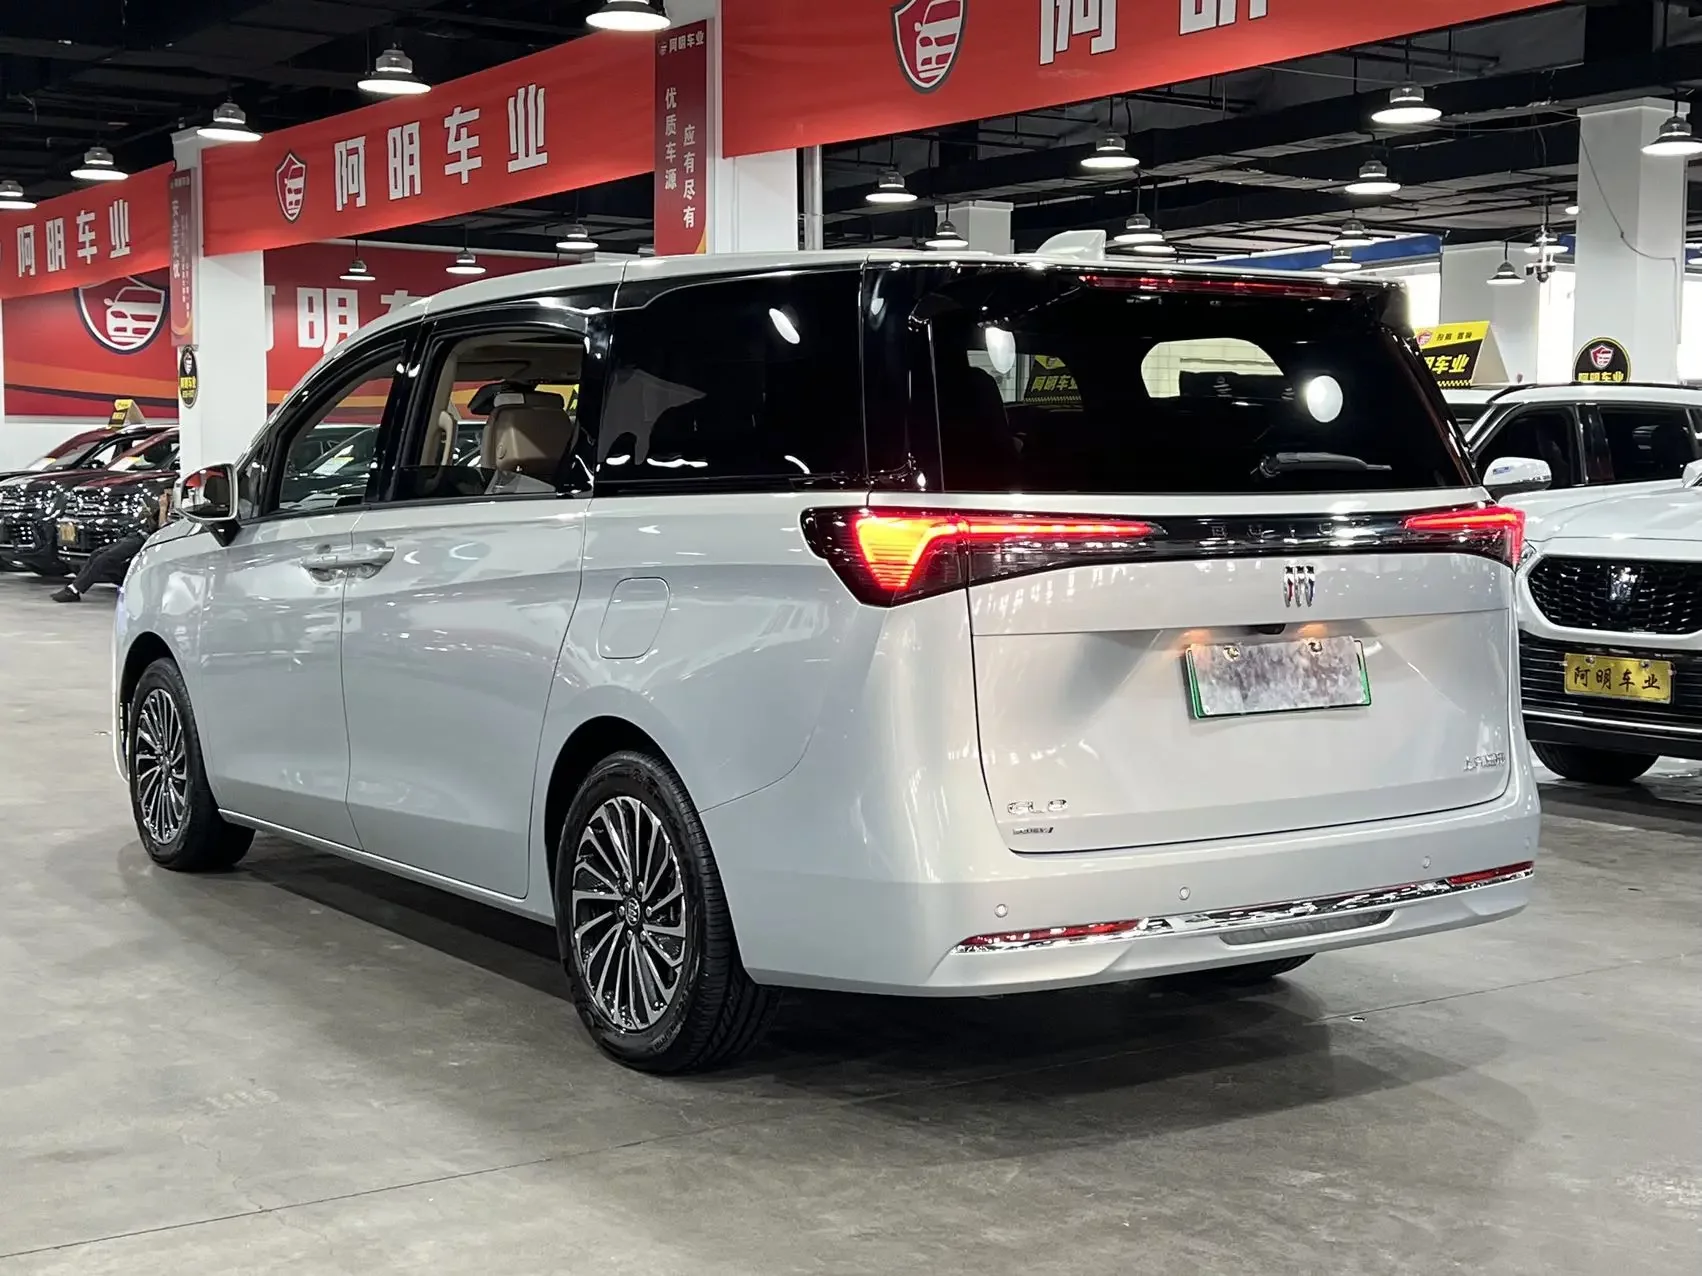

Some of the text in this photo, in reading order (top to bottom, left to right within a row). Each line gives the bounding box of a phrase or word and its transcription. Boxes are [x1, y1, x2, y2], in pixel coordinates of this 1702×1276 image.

[669, 30, 705, 52] 阿明车业
[334, 84, 548, 212] 阿明车业
[664, 87, 677, 190] 优质车源
[683, 123, 696, 229] 应有尽有
[16, 199, 131, 278] 阿明车业
[1573, 666, 1661, 692] 阿明车业
